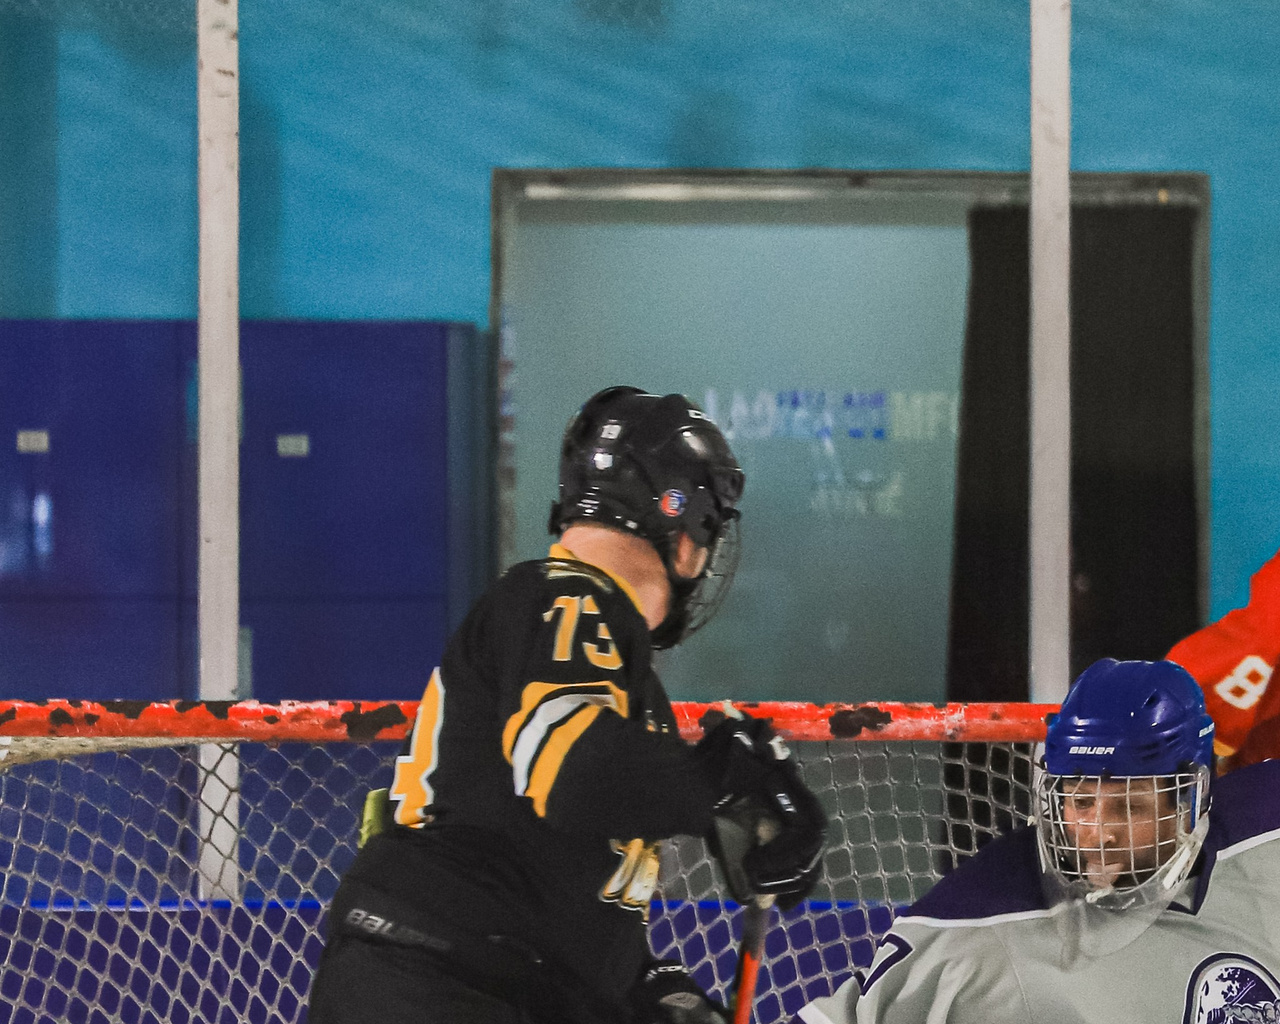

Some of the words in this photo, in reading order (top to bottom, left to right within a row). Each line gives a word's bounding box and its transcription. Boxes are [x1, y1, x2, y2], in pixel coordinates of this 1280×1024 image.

[542, 595, 623, 671] 73
[1213, 654, 1274, 711] 8
[1069, 747, 1115, 755] BAUER
